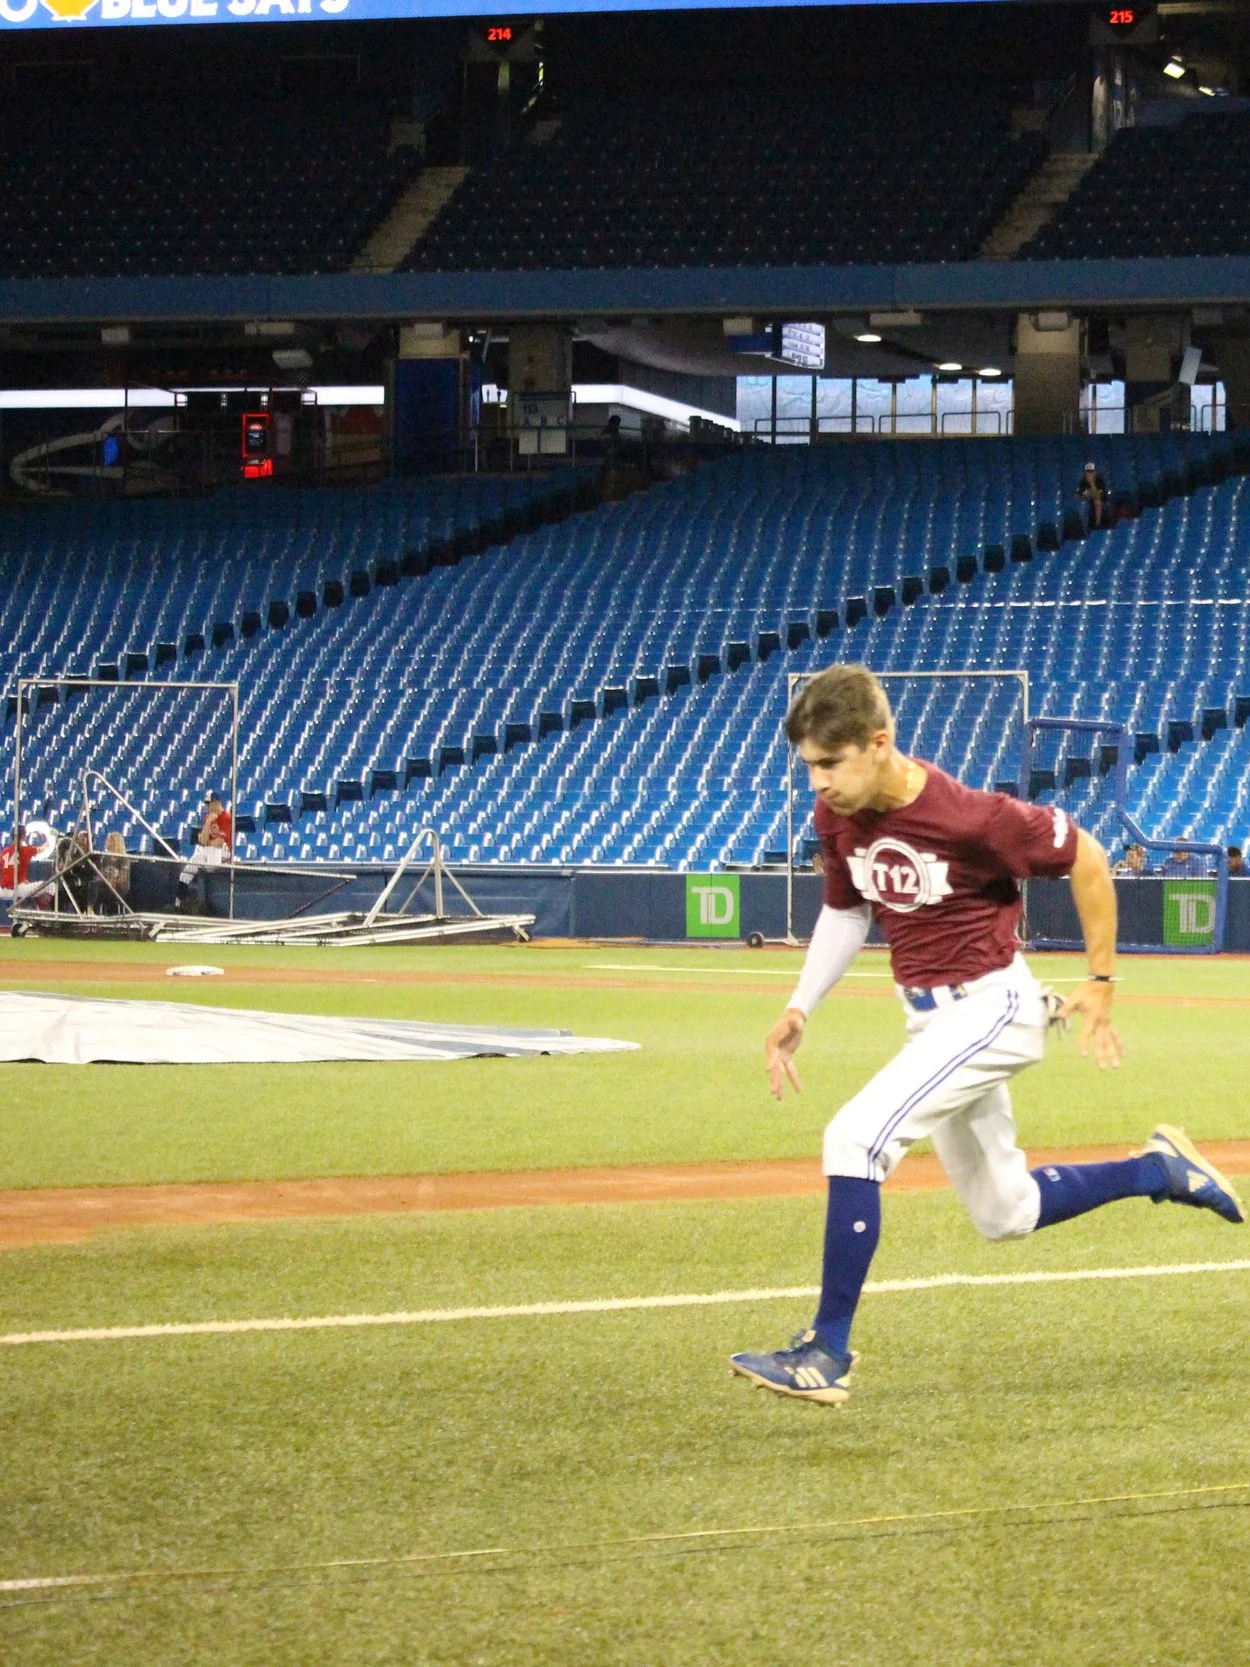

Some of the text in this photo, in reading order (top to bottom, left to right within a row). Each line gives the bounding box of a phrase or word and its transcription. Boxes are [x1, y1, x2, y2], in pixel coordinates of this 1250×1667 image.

[1109, 10, 1134, 24] 215
[487, 27, 512, 41] 214
[872, 862, 919, 894] T12
[691, 886, 734, 925] TD
[1168, 894, 1216, 933] TD
